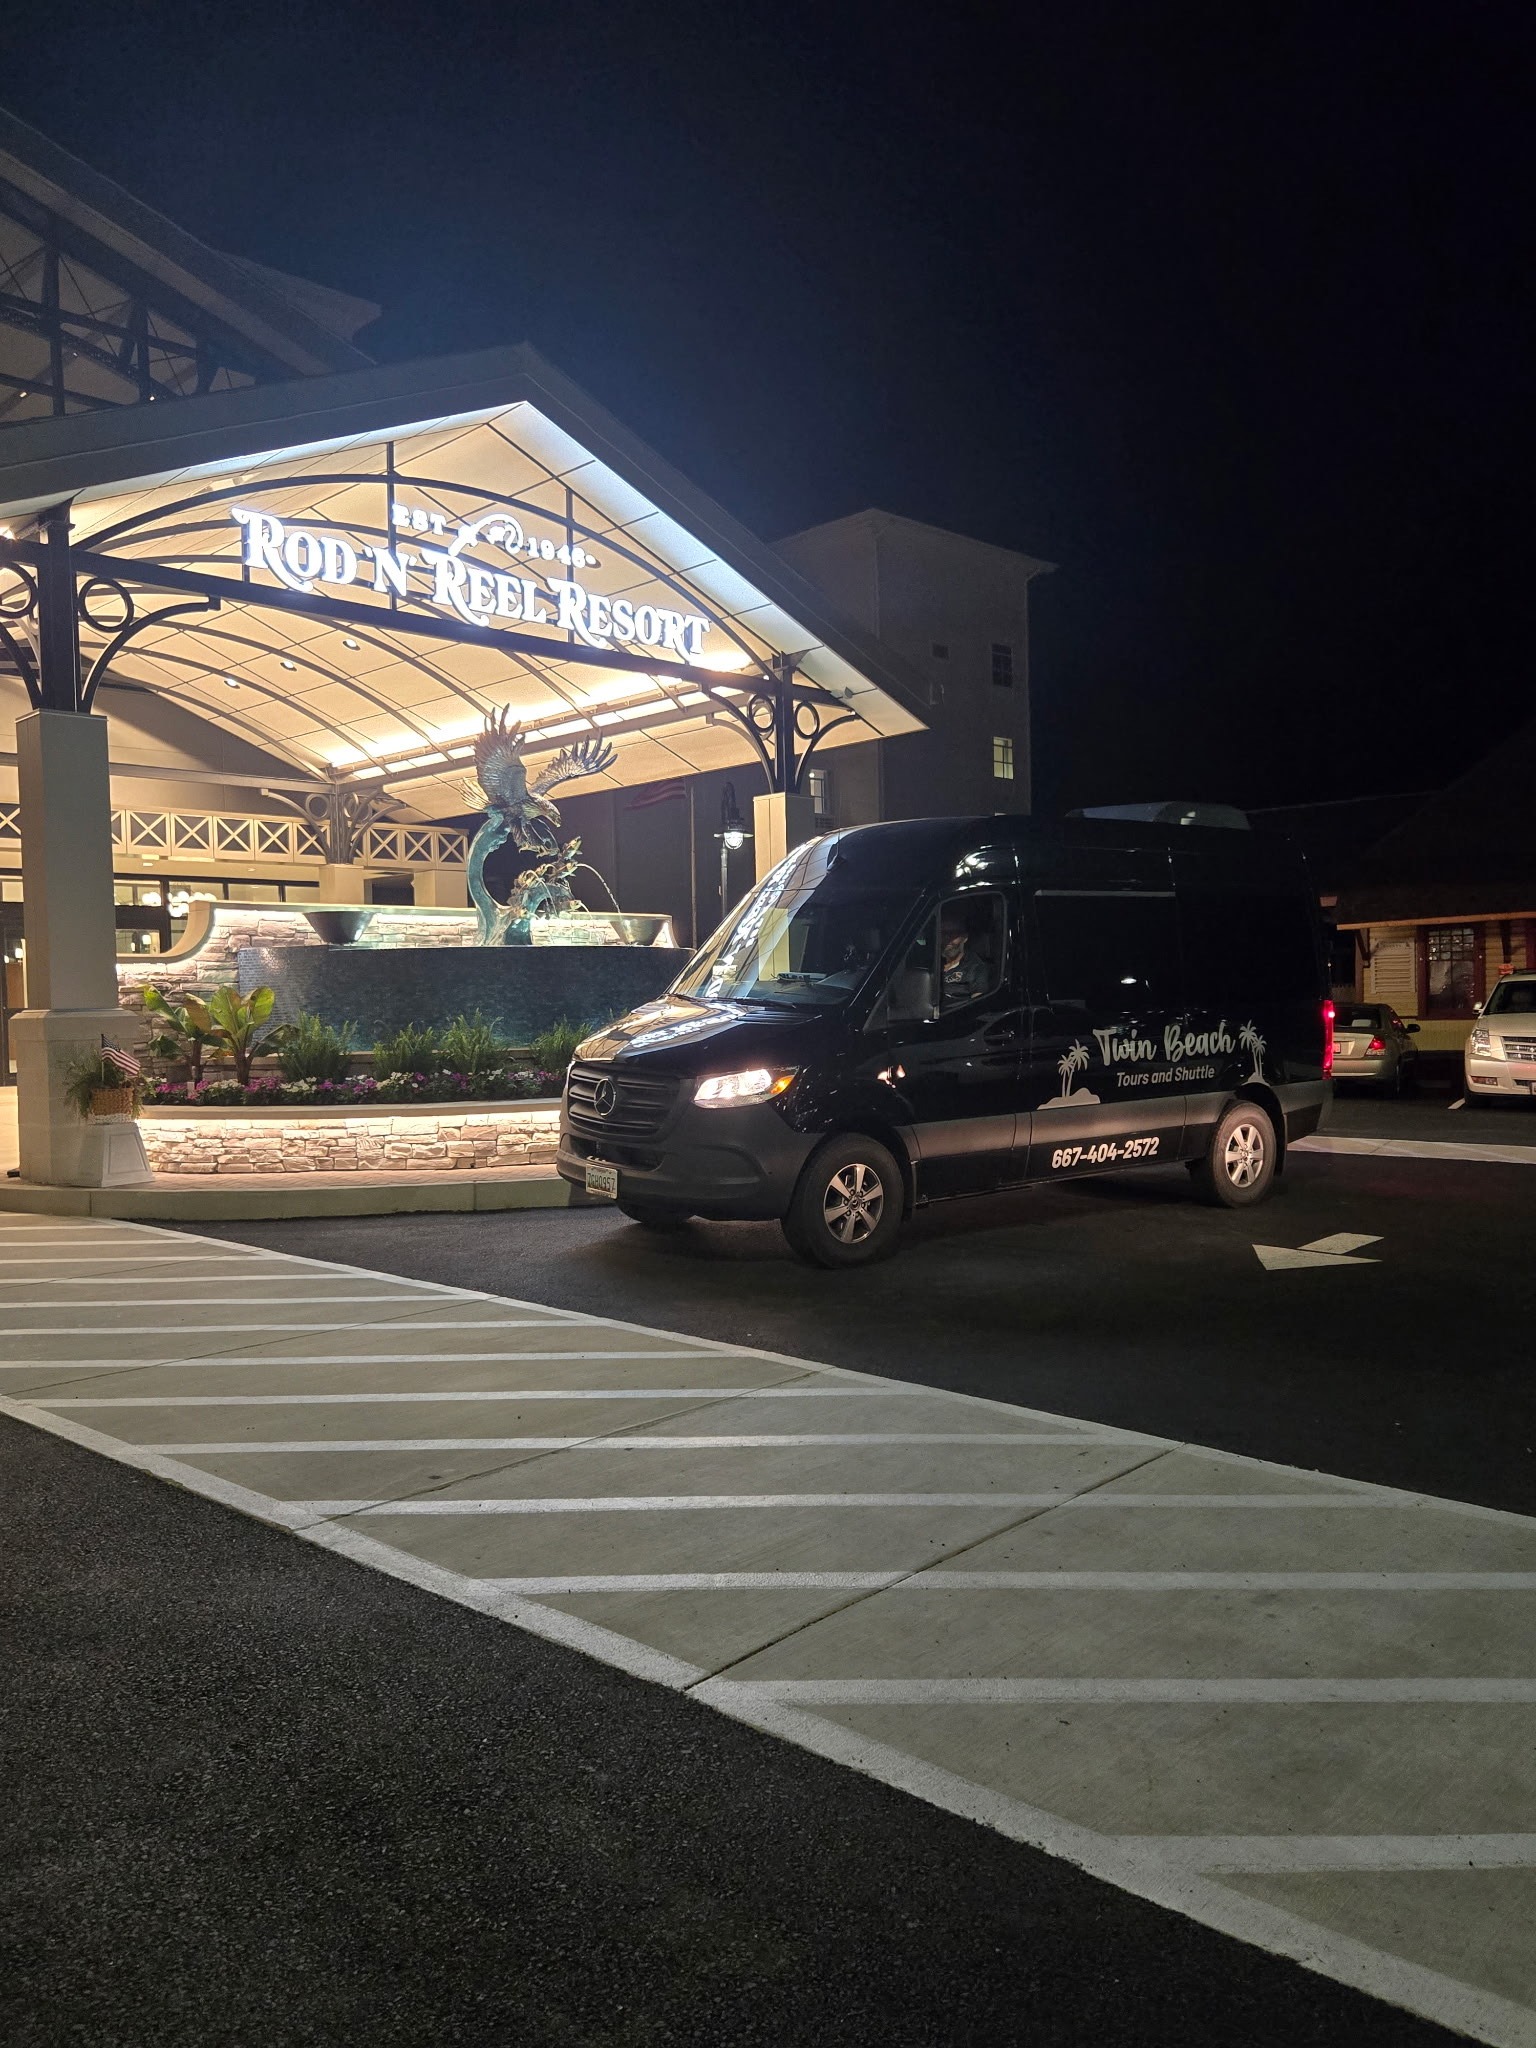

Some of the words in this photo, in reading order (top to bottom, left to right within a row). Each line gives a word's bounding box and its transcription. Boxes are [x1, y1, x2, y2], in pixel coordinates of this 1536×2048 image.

[231, 507, 358, 592] ROD
[420, 548, 547, 627] REEL
[546, 577, 710, 666] RESORT
[1093, 1028, 1157, 1066] Twin
[1163, 1022, 1236, 1063] Beach
[1117, 1072, 1150, 1088] Tours
[1151, 1067, 1173, 1084] and
[1174, 1065, 1216, 1082] Shuttle
[1051, 1136, 1160, 1169] 667-404-2572
